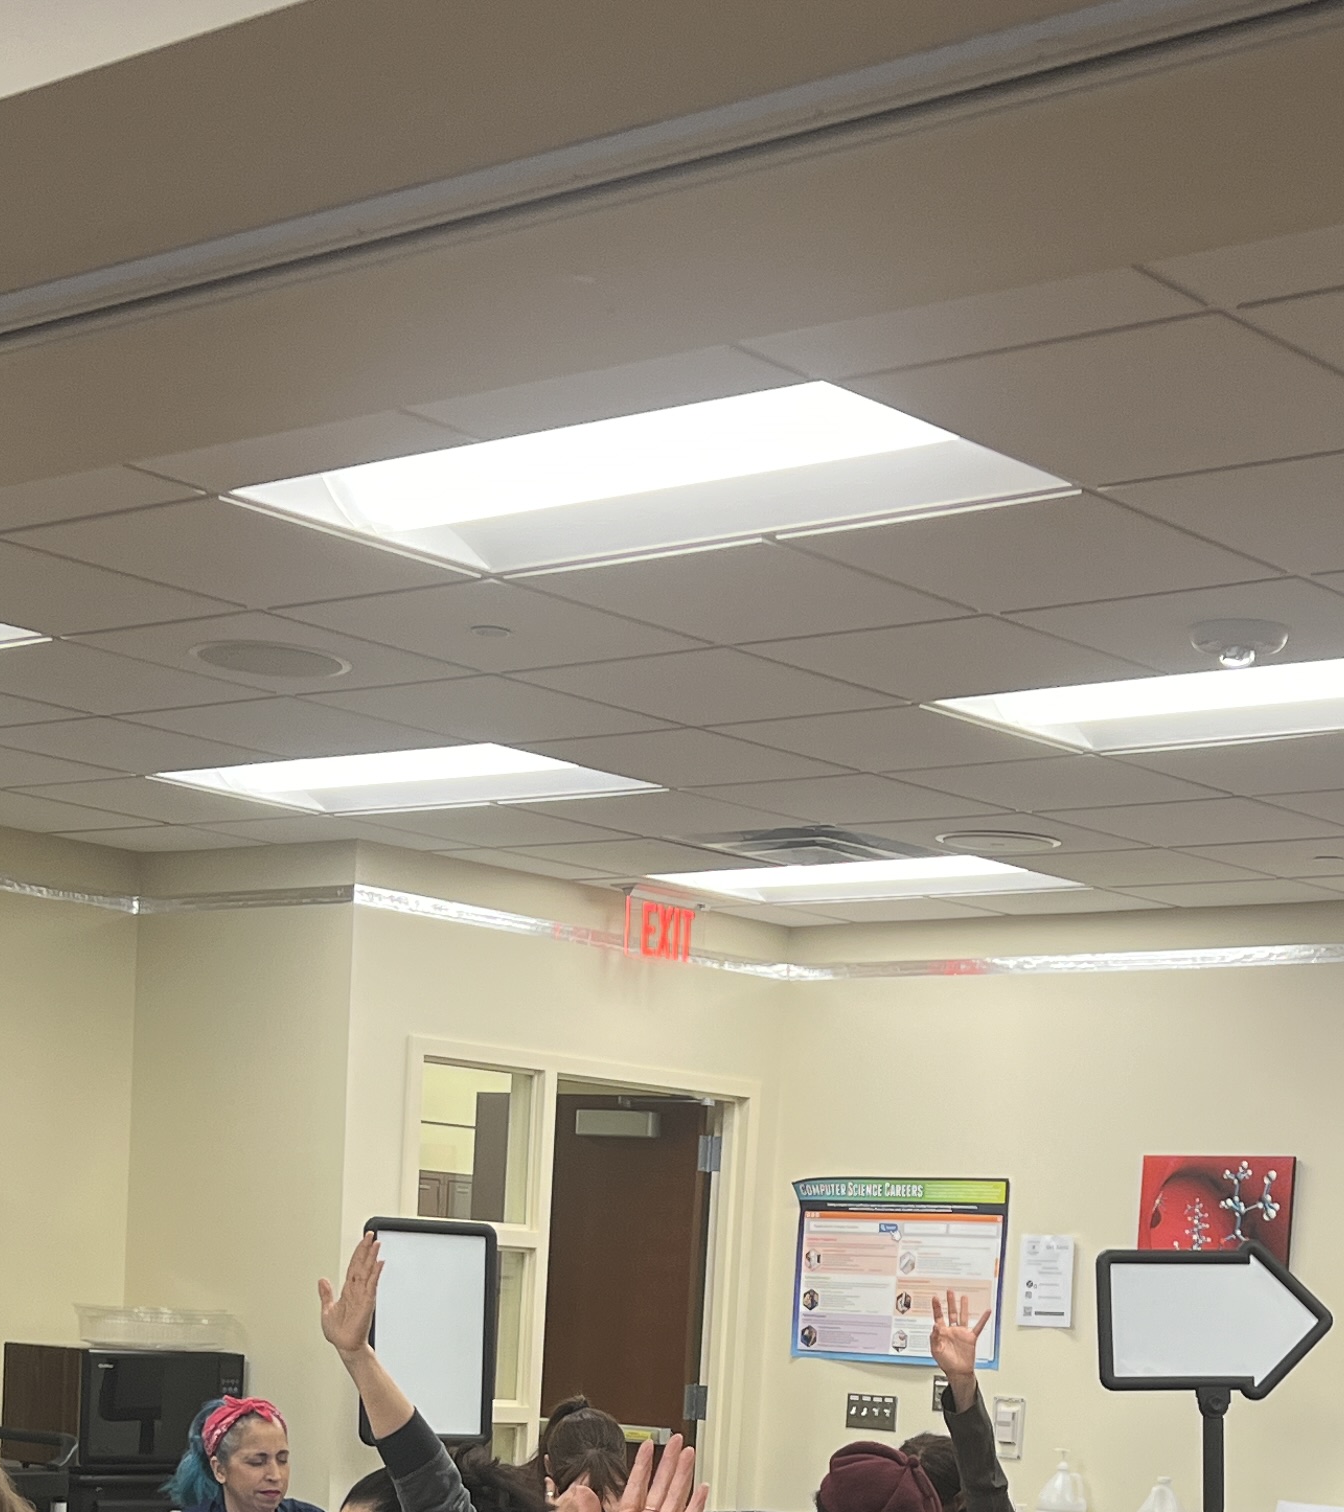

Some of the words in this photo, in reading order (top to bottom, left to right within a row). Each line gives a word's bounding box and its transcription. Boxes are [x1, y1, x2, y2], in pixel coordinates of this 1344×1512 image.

[641, 901, 696, 963] EXIT
[799, 1182, 846, 1197] COMPUTER
[847, 1182, 882, 1197] SCIENCE
[884, 1183, 924, 1198] CAREERS
